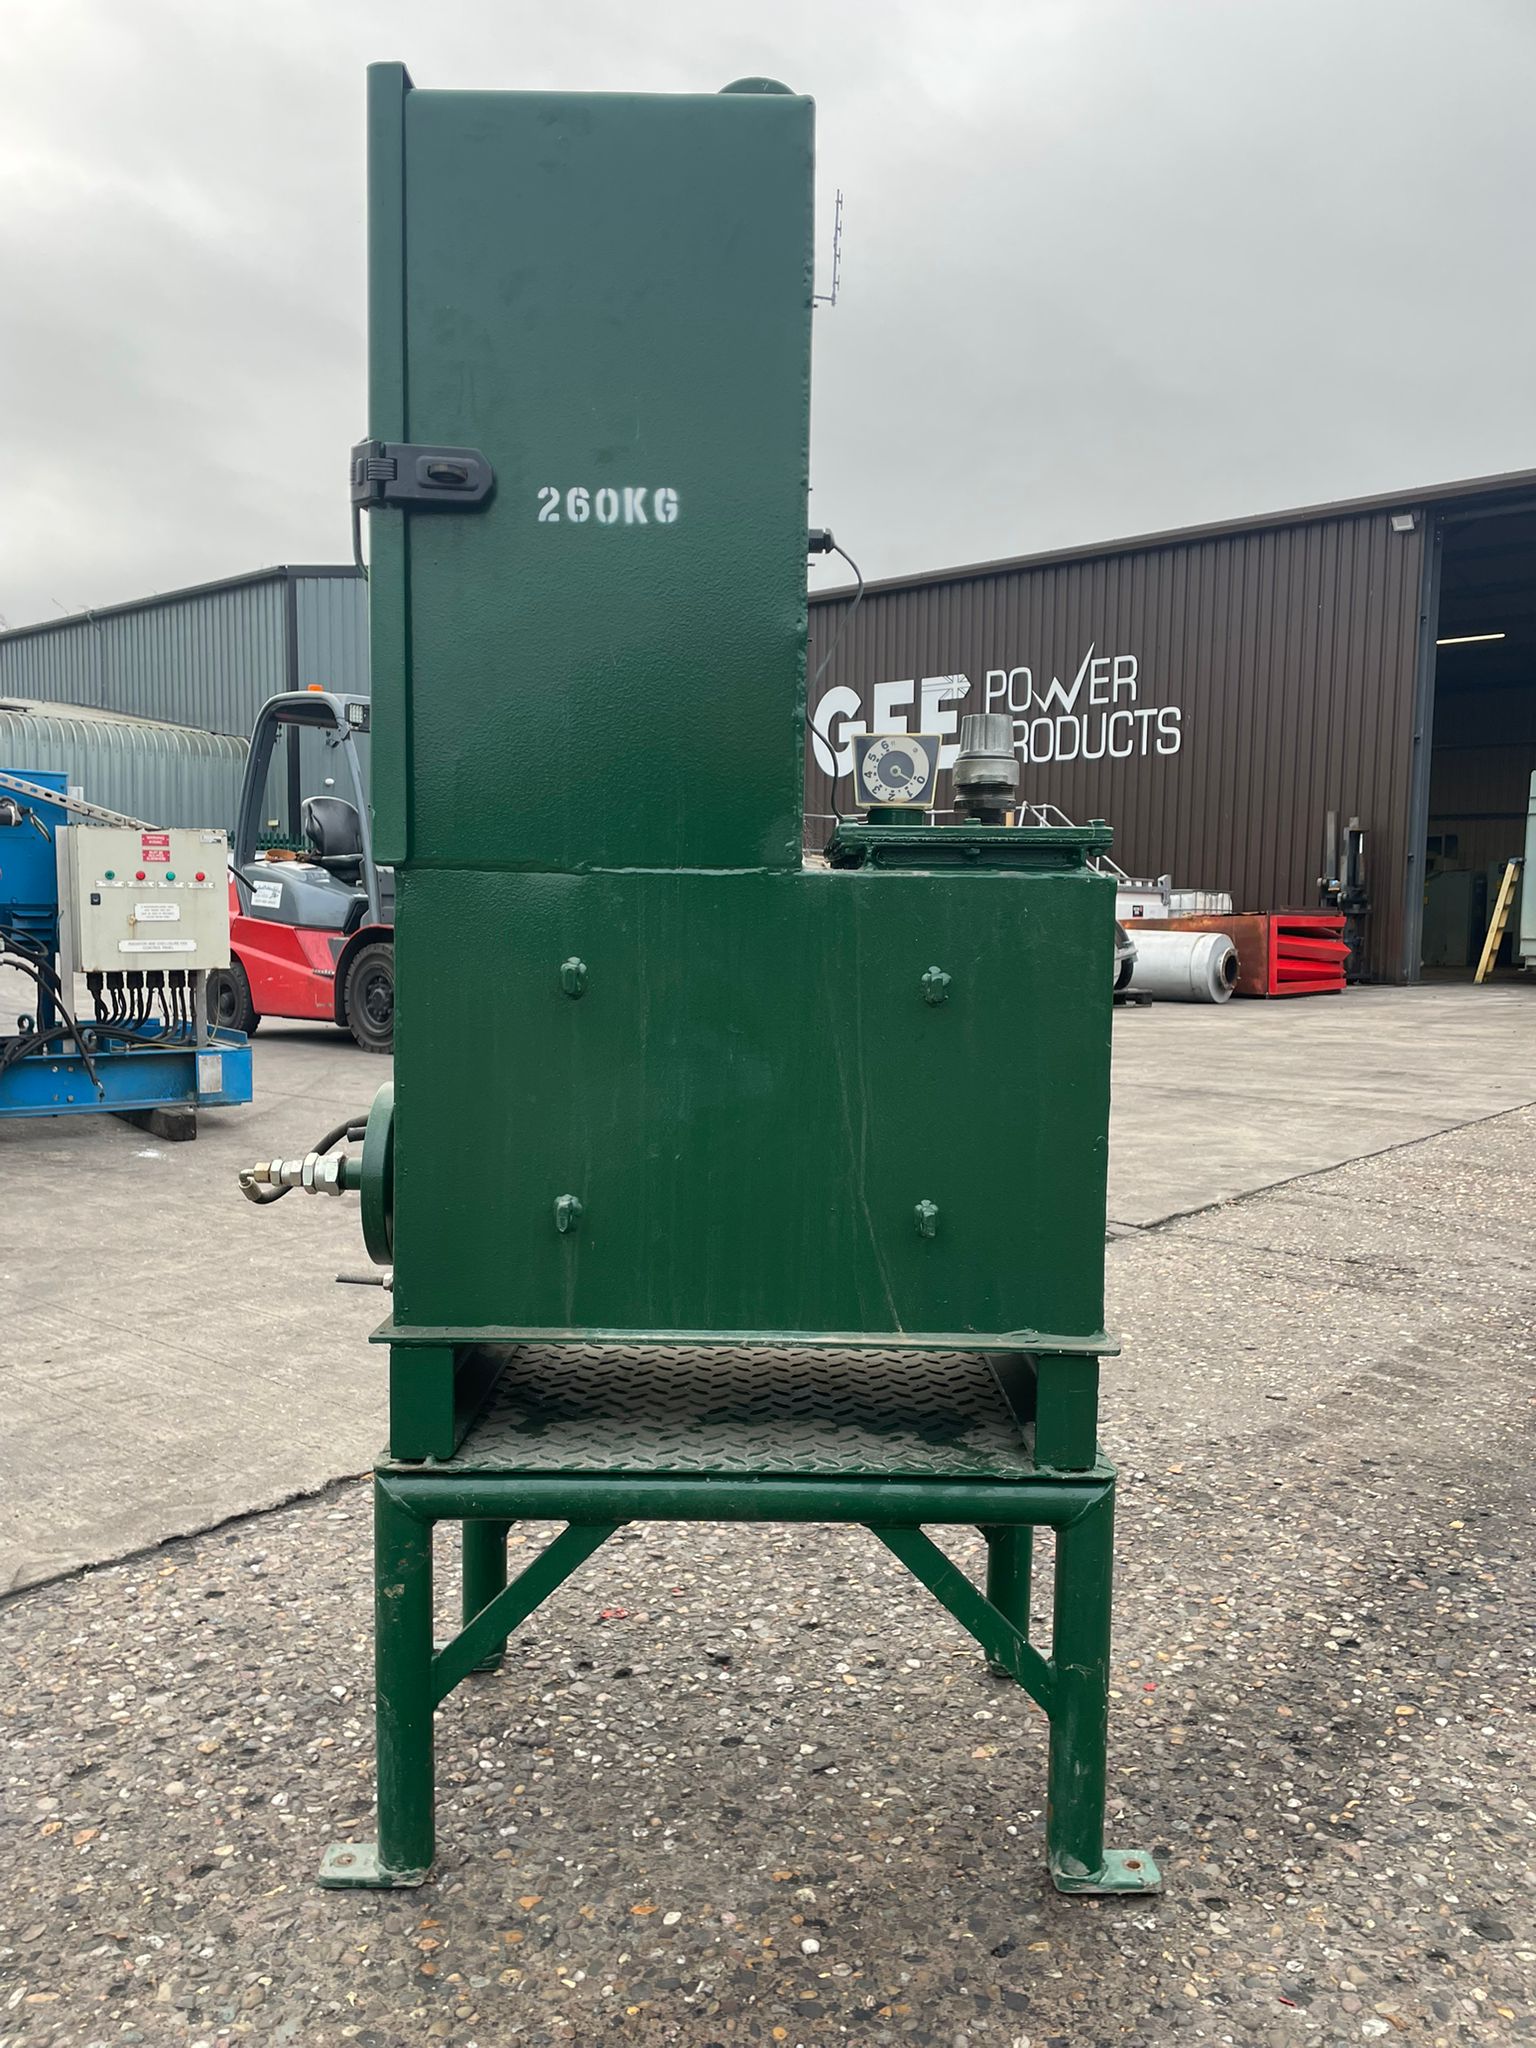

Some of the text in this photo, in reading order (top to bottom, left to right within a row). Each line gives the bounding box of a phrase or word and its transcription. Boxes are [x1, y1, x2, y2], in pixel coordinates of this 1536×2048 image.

[538, 487, 678, 524] 260KG
[985, 641, 1138, 714] POWER
[1013, 706, 1182, 763] RODUCTS
